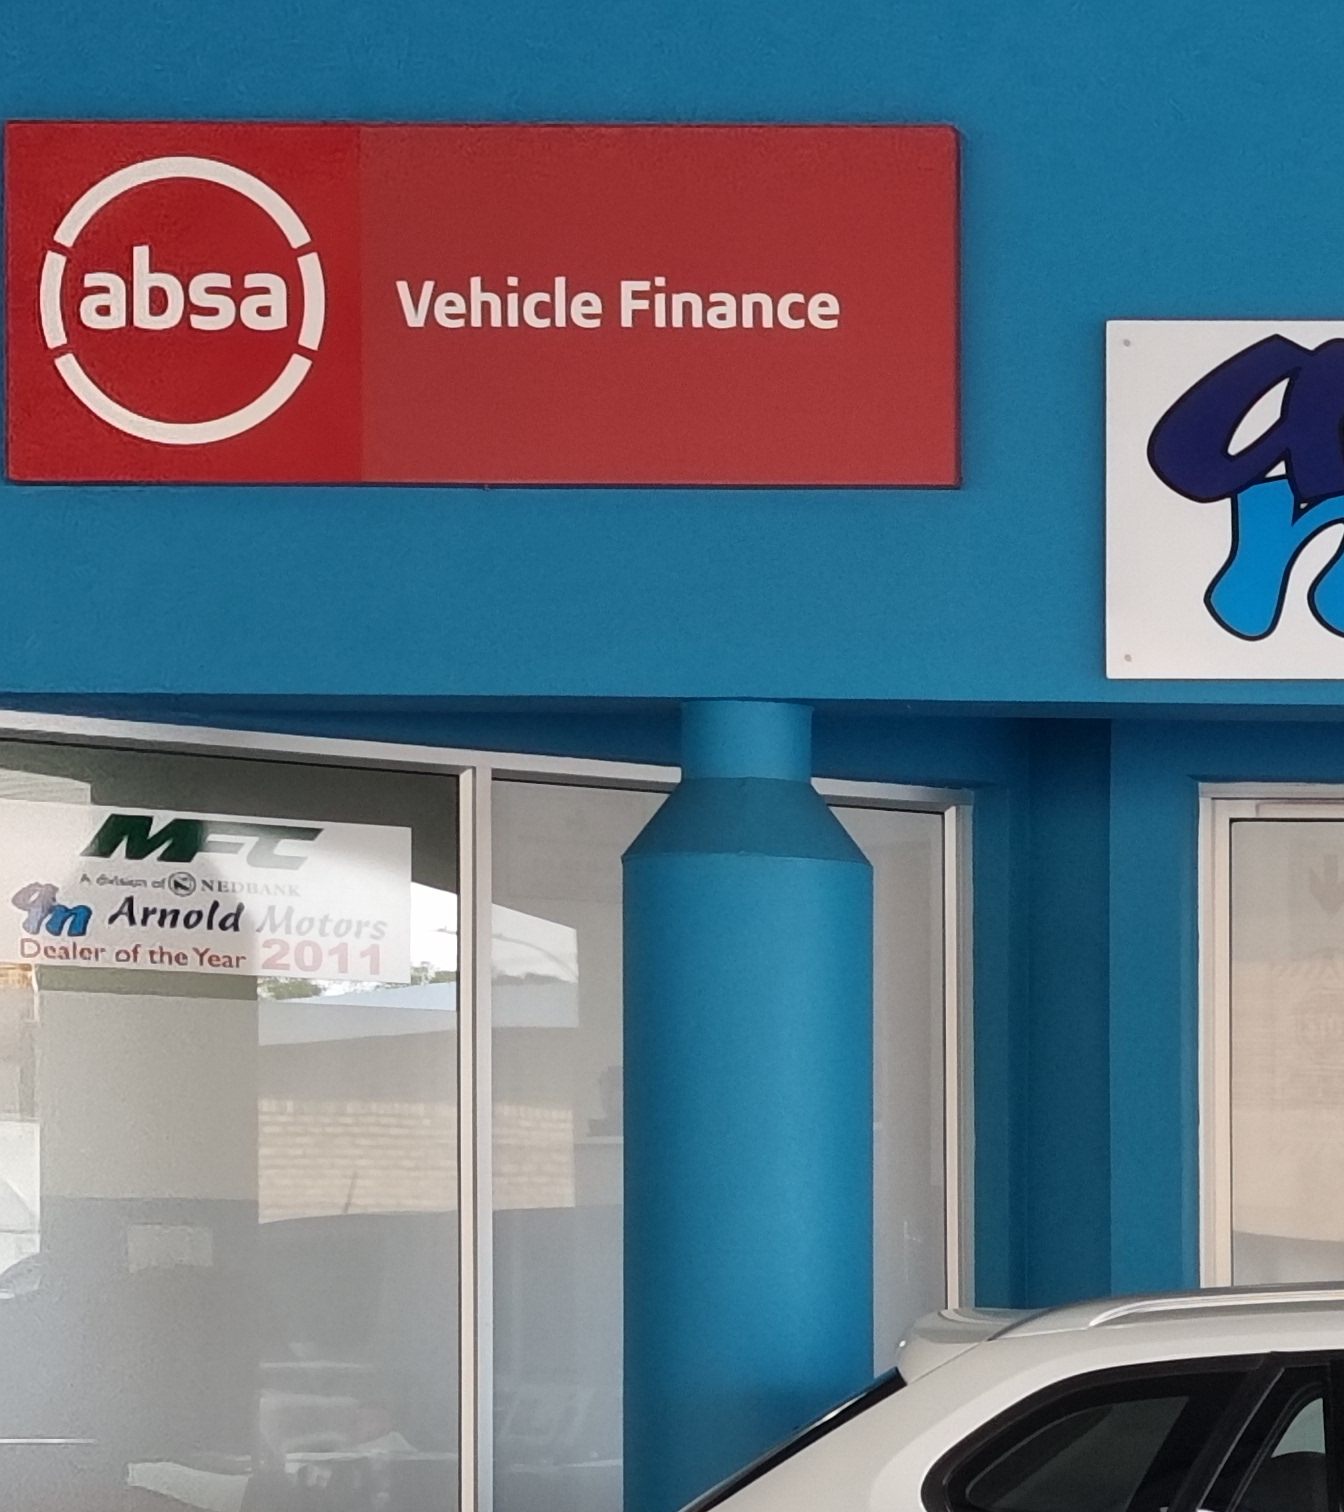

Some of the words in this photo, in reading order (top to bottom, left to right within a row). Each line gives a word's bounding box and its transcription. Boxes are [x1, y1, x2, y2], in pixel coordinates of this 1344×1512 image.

[78, 245, 290, 331] absa
[397, 276, 602, 330] Vehicle
[619, 278, 841, 330] Finance
[80, 813, 324, 871] MFC
[201, 879, 301, 898] NEDBANK
[107, 895, 246, 933] Arnold
[255, 907, 388, 941] Motors
[20, 938, 106, 964] Dealer
[115, 944, 142, 964] of
[149, 947, 189, 966] the
[193, 947, 246, 970] Year
[261, 939, 381, 976] 2011
